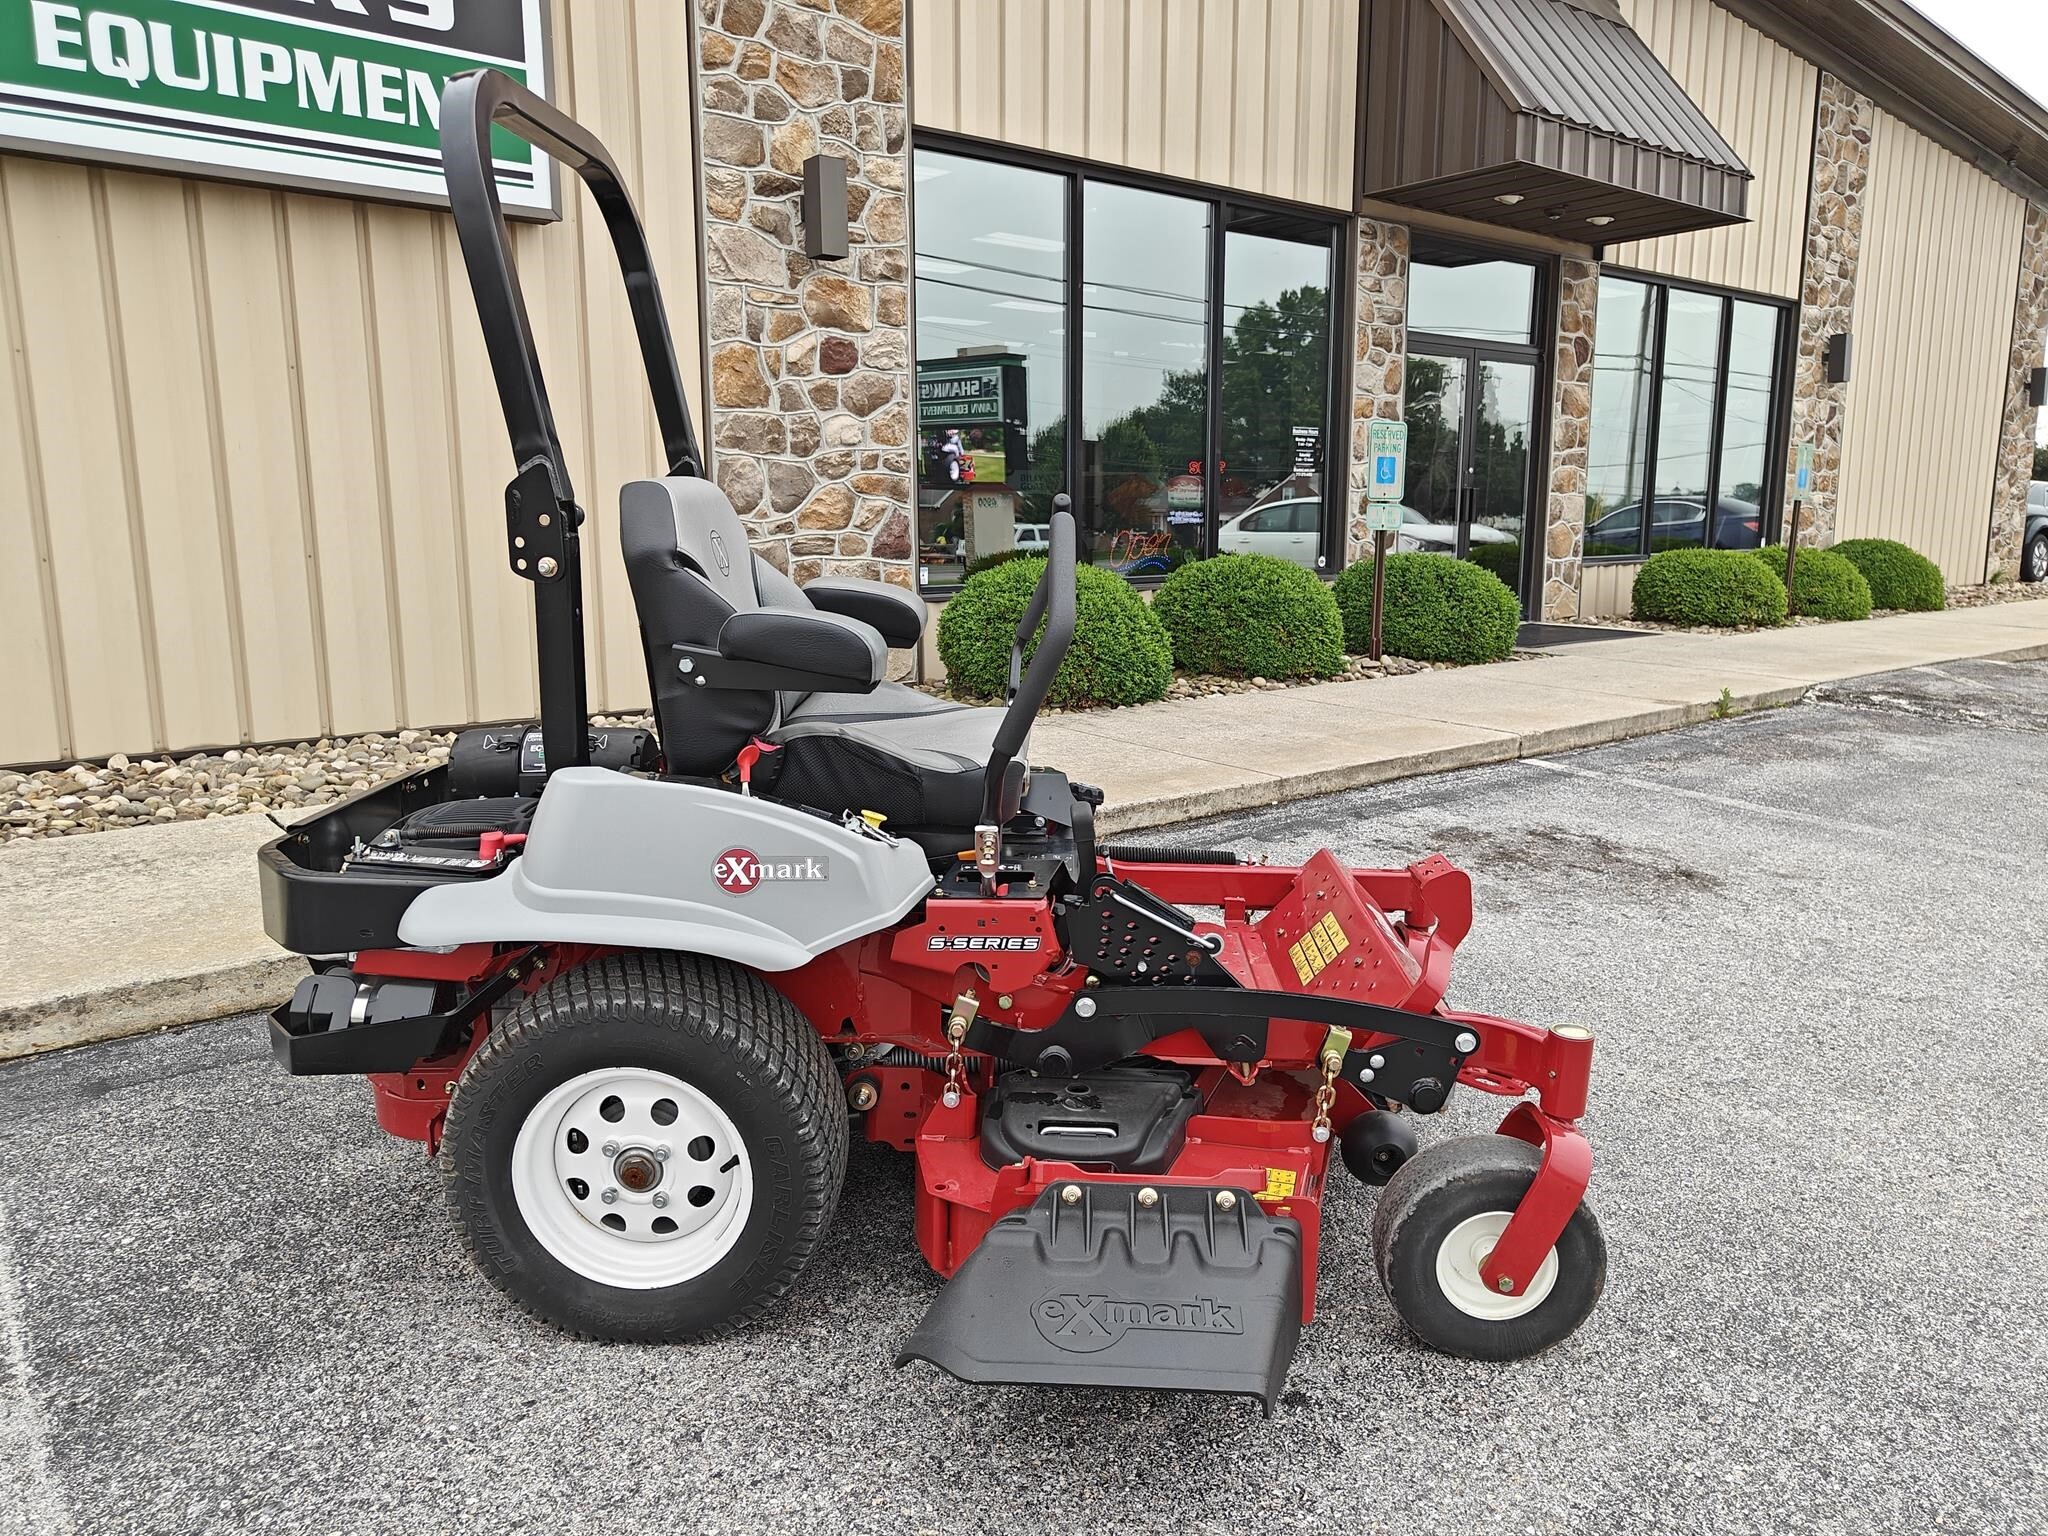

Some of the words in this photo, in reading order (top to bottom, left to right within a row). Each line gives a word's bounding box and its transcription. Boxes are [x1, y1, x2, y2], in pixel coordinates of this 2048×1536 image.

[31, 0, 446, 131] EQUIPMEN
[1373, 428, 1404, 440] RESERVED
[1373, 442, 1402, 454] PARKING
[1110, 530, 1172, 568] Open
[713, 857, 824, 885] eXmark
[928, 936, 1040, 951] S-SERIES
[463, 1052, 546, 1186] MASTER
[465, 1190, 521, 1275] TURF
[728, 1134, 794, 1299] CARLISLE
[1037, 1293, 1236, 1337] eXmark
